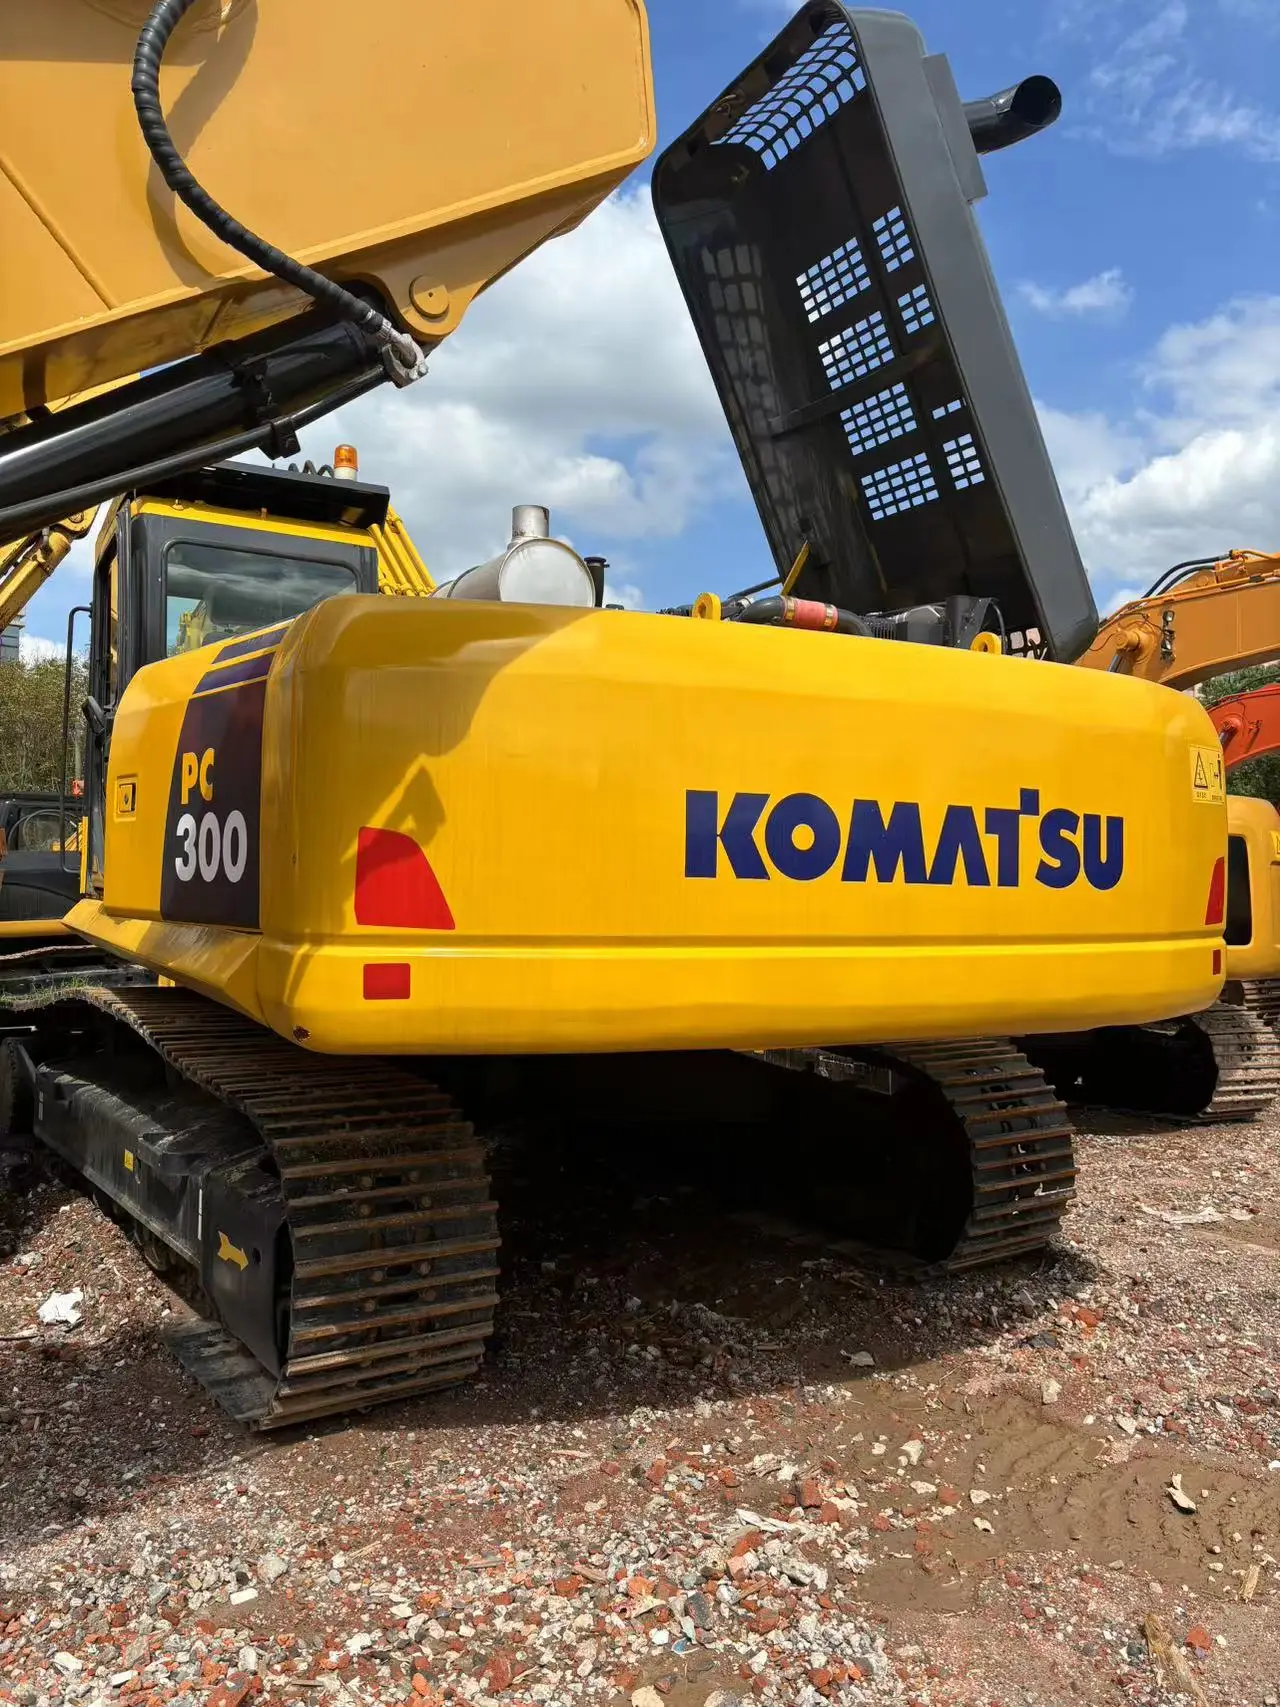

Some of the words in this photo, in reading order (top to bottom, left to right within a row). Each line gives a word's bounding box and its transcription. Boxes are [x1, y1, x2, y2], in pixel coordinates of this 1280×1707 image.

[180, 747, 215, 805] PC
[174, 809, 248, 883] 300
[684, 787, 1125, 891] KOMATSU
